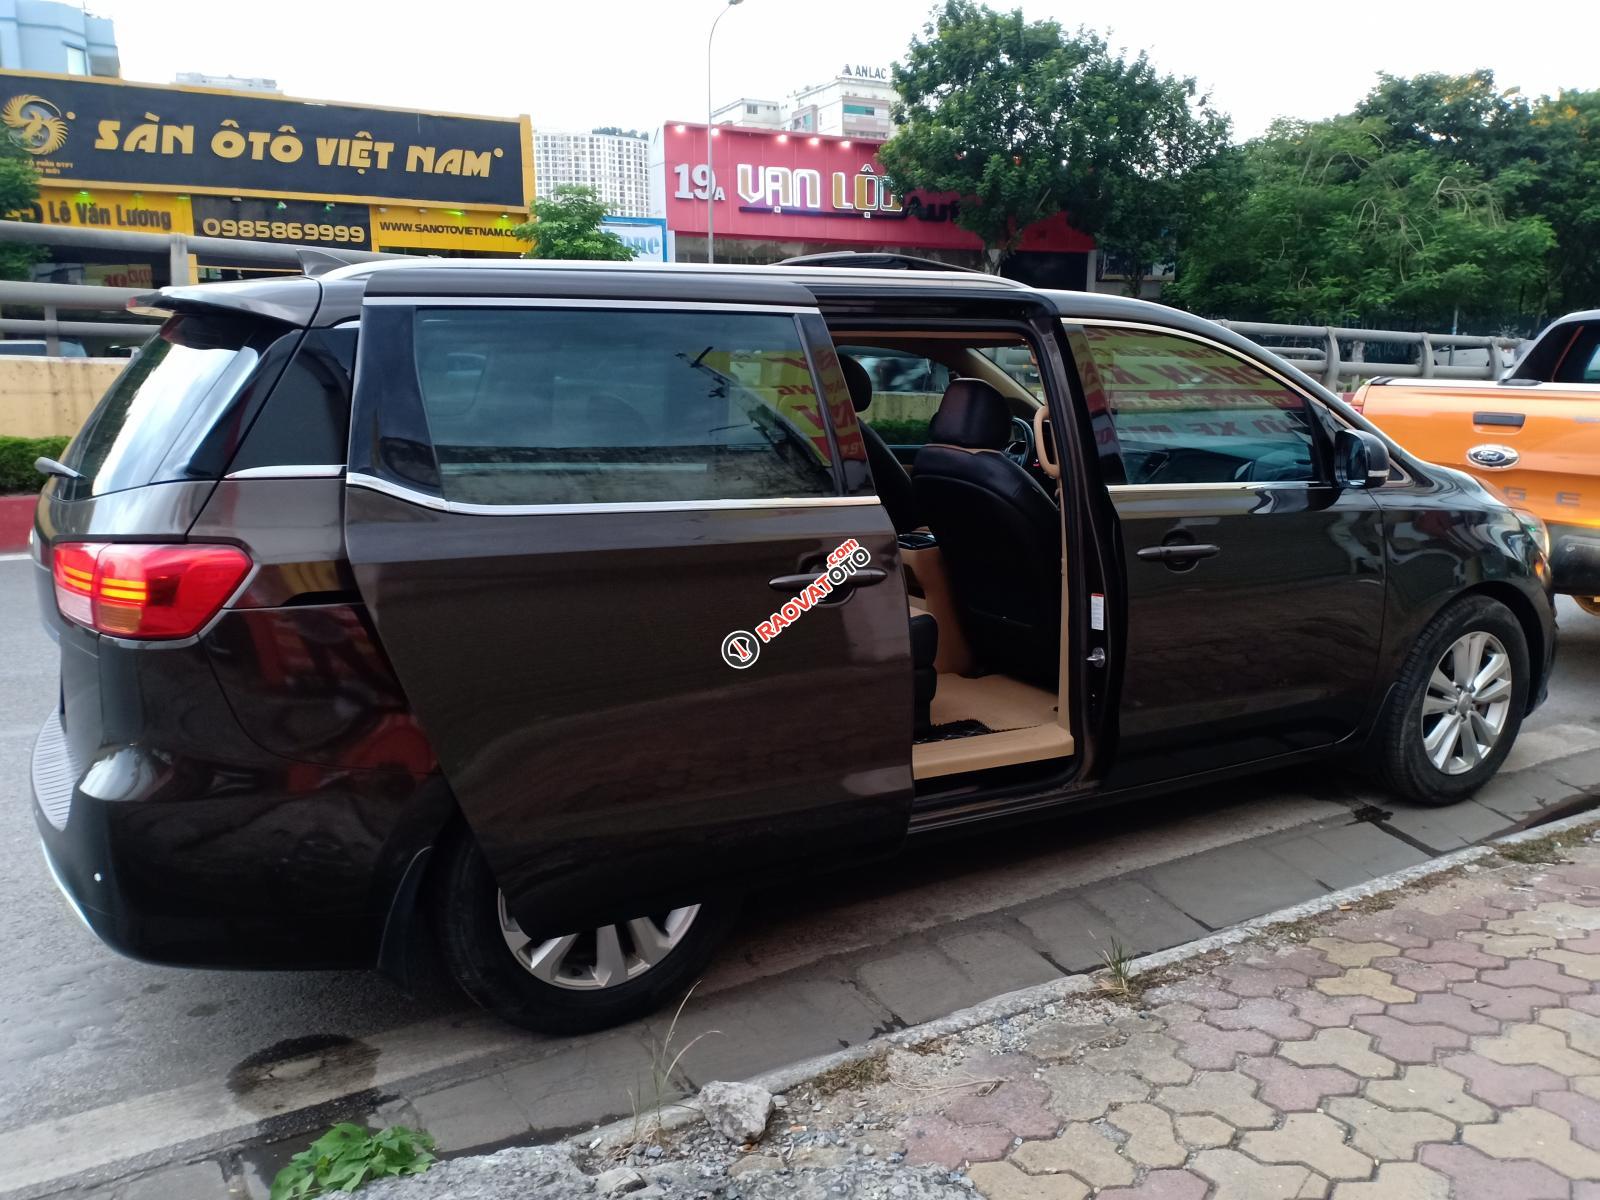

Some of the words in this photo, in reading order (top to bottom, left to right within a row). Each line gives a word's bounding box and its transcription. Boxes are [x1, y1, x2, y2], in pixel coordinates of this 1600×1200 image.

[95, 112, 195, 154] SÀN
[211, 119, 303, 163] ÔTÔ
[316, 131, 395, 175] VIỆT
[406, 145, 491, 177] NAM
[737, 163, 821, 213] VẠN
[48, 201, 71, 223] Lê
[75, 202, 112, 226] Văn
[115, 204, 172, 231] Lương
[203, 218, 365, 243] 0985869999
[379, 221, 518, 238] WWW.SANOTOVIETNAM.CO
